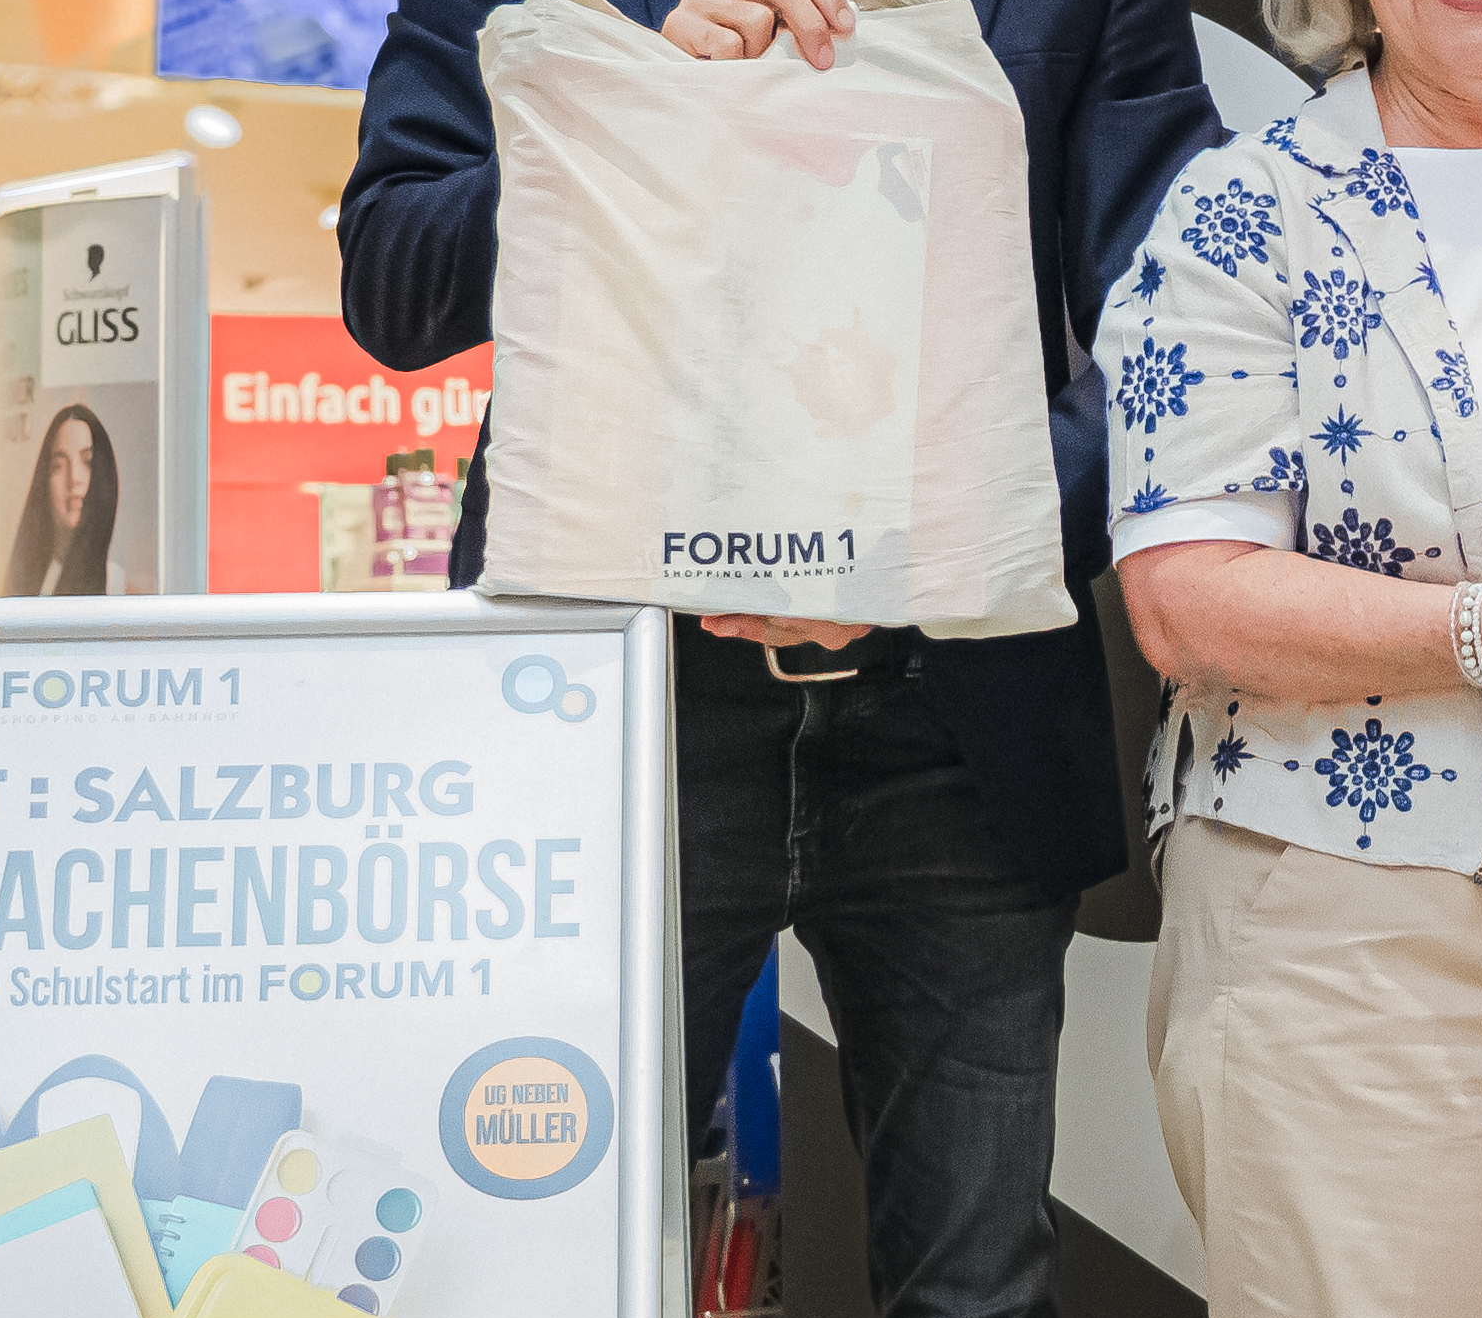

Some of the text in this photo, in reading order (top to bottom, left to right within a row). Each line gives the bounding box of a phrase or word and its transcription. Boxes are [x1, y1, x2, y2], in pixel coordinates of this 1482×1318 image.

[57, 307, 139, 345] GLISS
[223, 373, 401, 424] Einfach
[663, 528, 855, 565] FORUM 1
[663, 565, 856, 579] SHOPPING AM BAHNHOF
[2, 667, 241, 709] FORUM 1
[1, 711, 242, 725] SHOPPING AM BAHNHOF
[73, 759, 474, 824] SALZBURG
[10, 965, 191, 1008] Schulstart
[202, 964, 244, 1004] im
[259, 960, 455, 1003] FORUM
[471, 959, 491, 996] 1
[484, 1083, 568, 1105] UG NEBEN
[475, 1109, 577, 1145] MÜLLER
